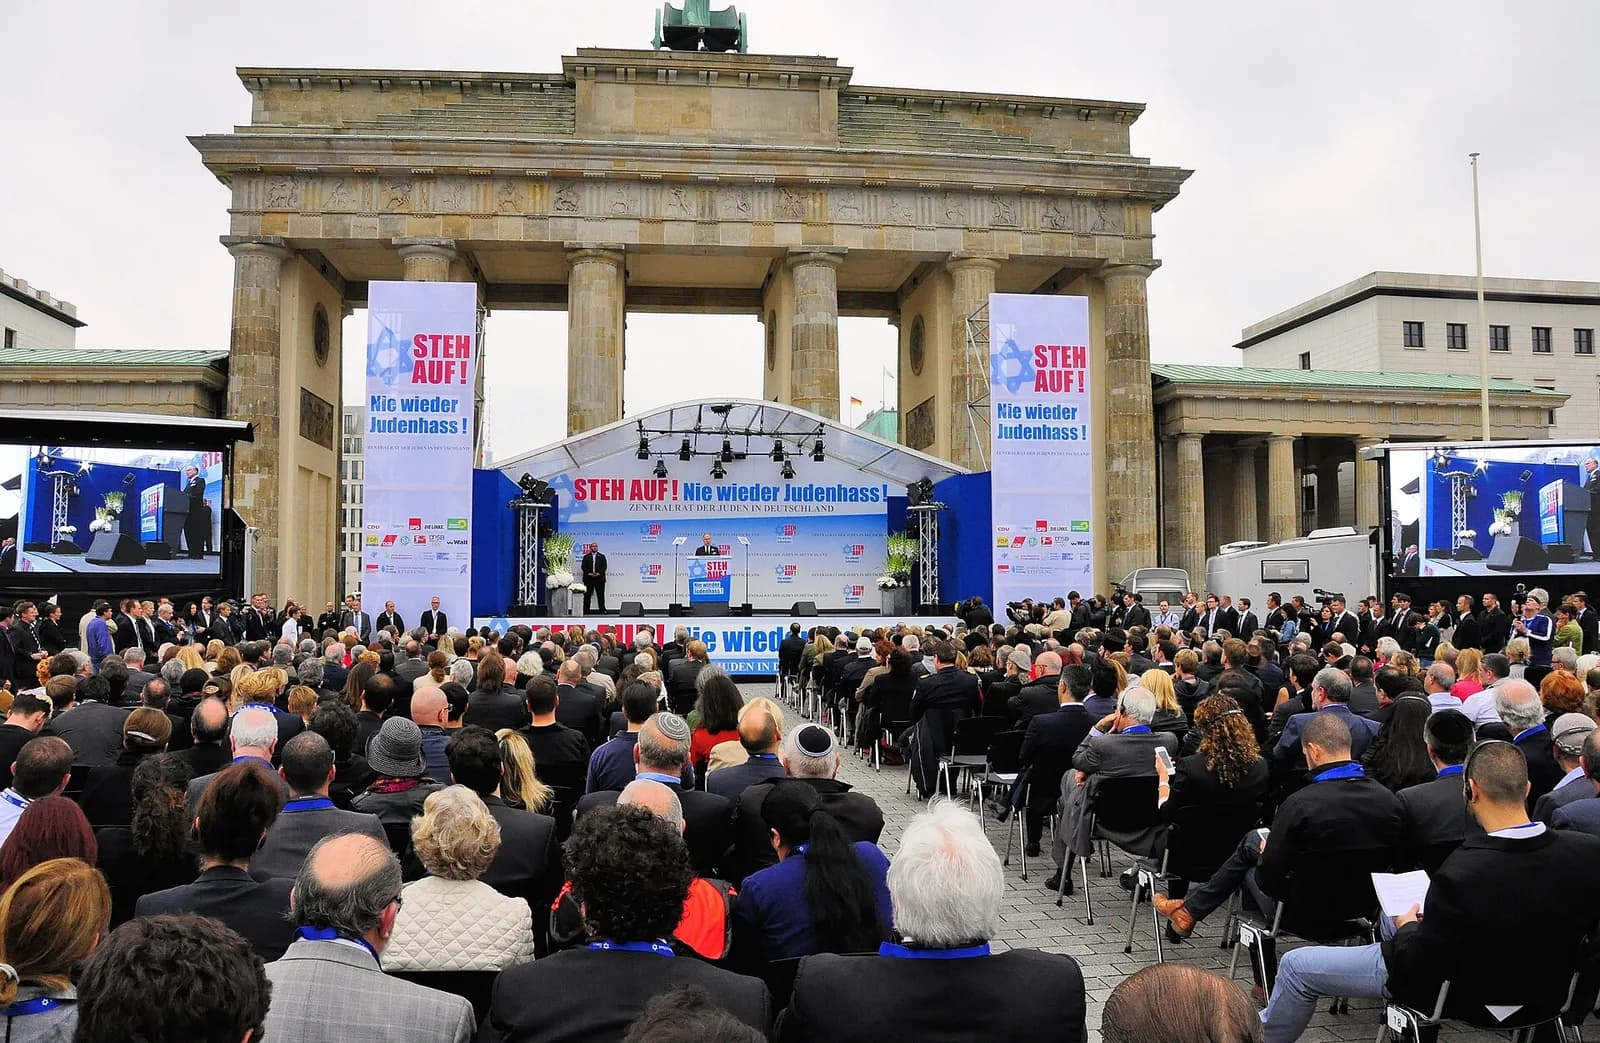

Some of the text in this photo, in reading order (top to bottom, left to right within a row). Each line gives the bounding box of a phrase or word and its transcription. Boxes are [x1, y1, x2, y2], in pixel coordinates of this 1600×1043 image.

[413, 334, 470, 358] STEH
[1034, 345, 1086, 368] STEH
[370, 395, 458, 413] Nie wieder
[997, 403, 1078, 420] Nie wieder
[574, 478, 625, 501] STEH
[683, 482, 712, 502] Nie
[716, 483, 780, 502] wieder
[629, 504, 834, 513] ZENTRALRAT DER JUDEN IN DEUTSCHLAND
[707, 561, 728, 570] STEH
[758, 662, 772, 672] IN
[1394, 1016, 1402, 1027] 18
